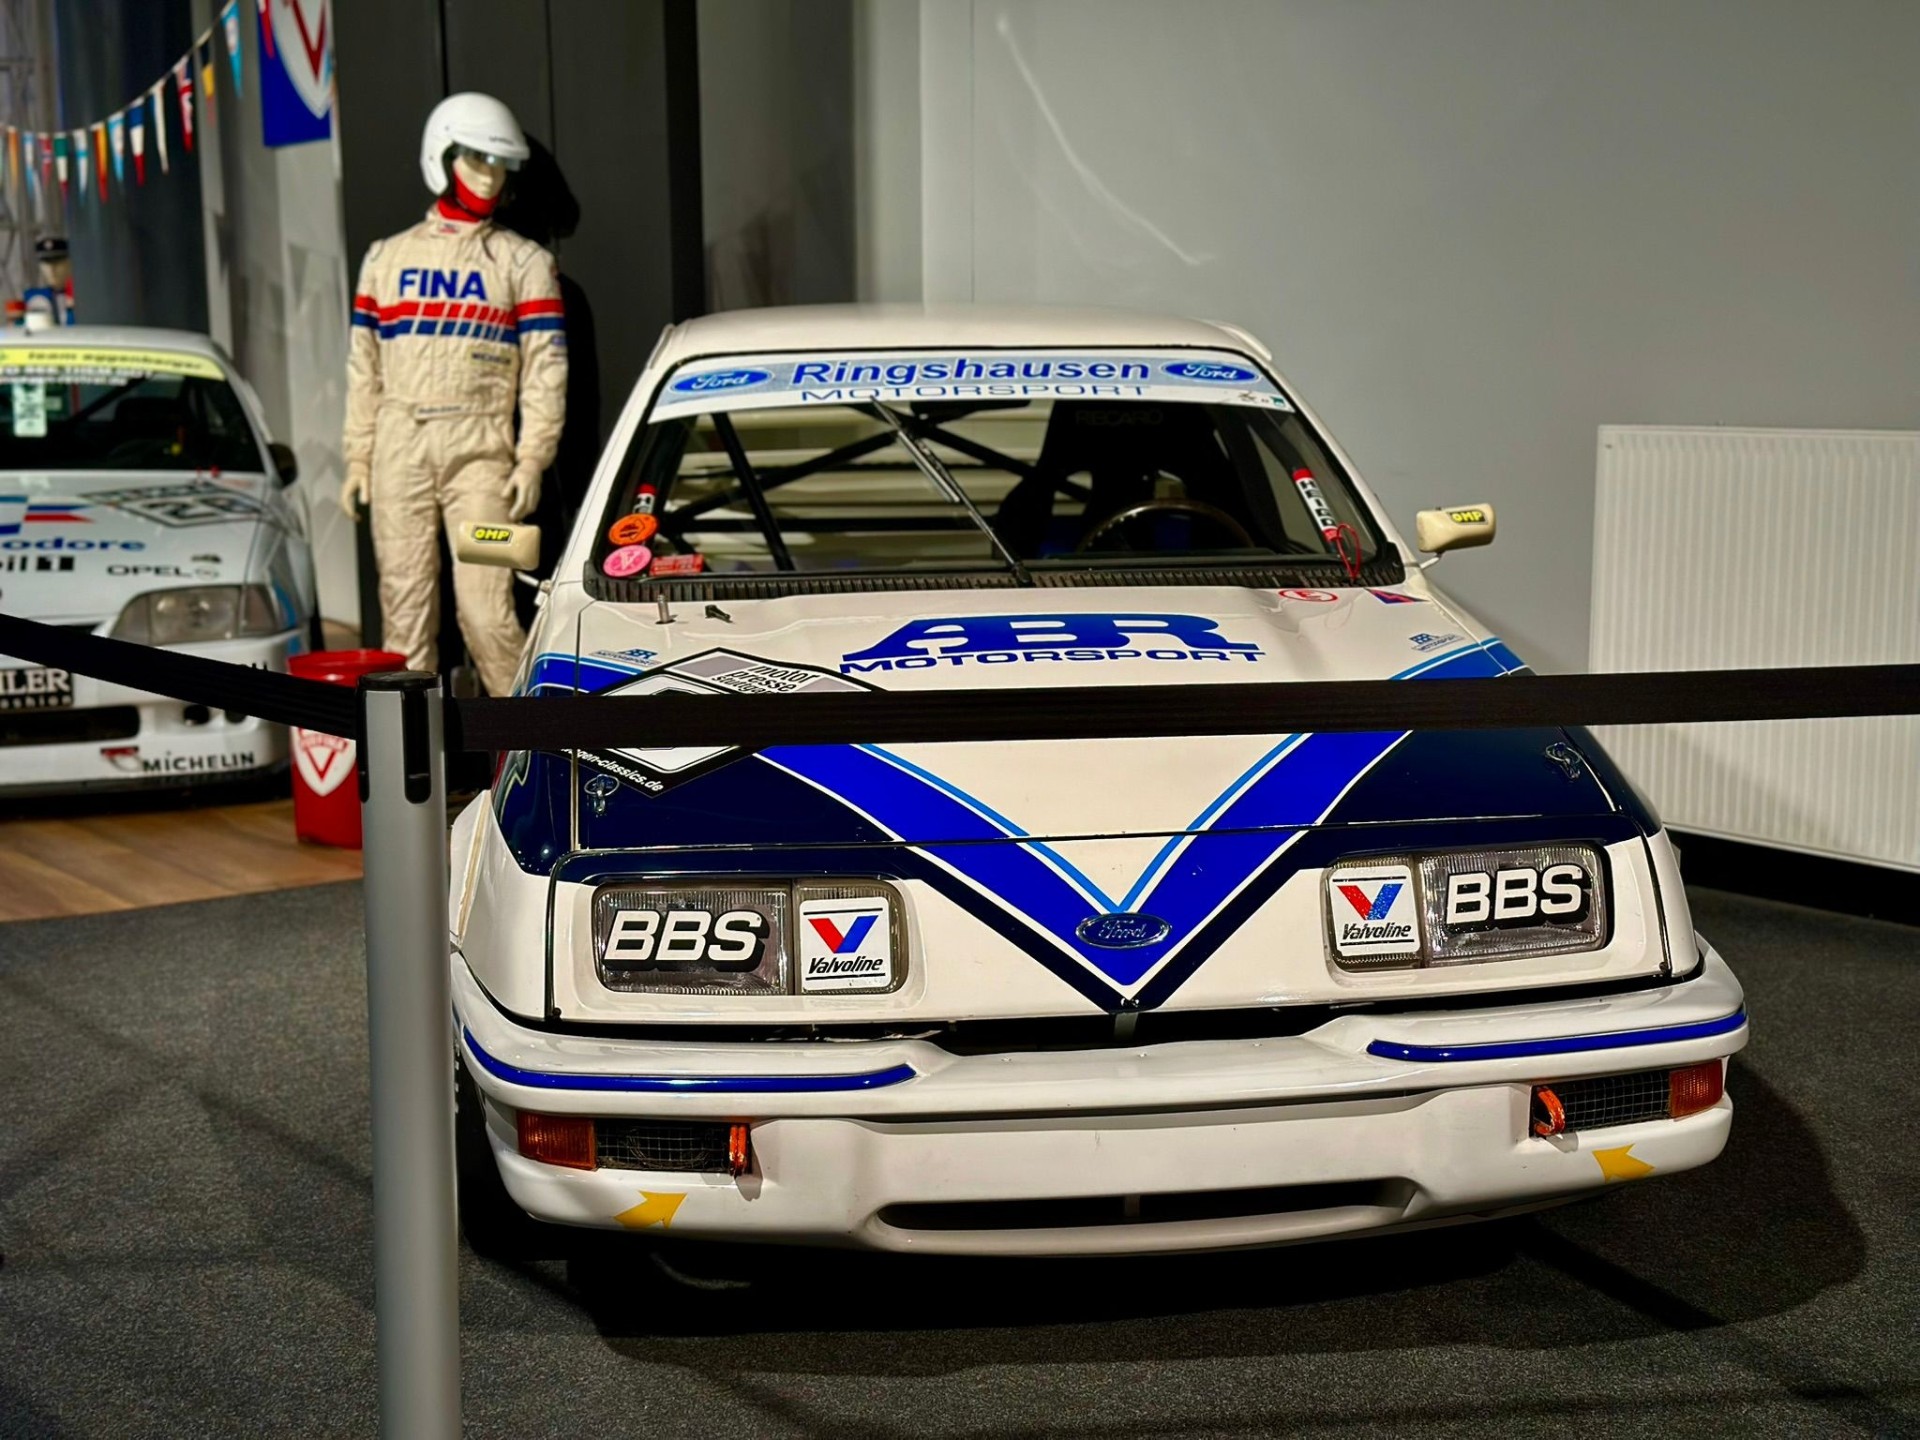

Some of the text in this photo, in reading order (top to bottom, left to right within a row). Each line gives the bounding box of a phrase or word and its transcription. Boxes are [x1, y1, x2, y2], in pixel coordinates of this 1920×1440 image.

[399, 269, 488, 300] FINA
[791, 358, 1150, 386] Ringshausen
[1182, 361, 1239, 380] Ford
[690, 371, 751, 391] Ford
[801, 384, 1151, 401] MOTORSPORT
[1452, 511, 1483, 523] OMP
[474, 528, 511, 540] OMP
[107, 565, 192, 578] OPEL
[838, 650, 1266, 674] MOTORSPORT
[724, 670, 798, 692] presse
[748, 664, 821, 684] motor
[1446, 864, 1589, 928] BBS
[603, 910, 768, 967] BBS
[1342, 921, 1412, 940] Valvoline
[808, 955, 884, 975] Valvoline
